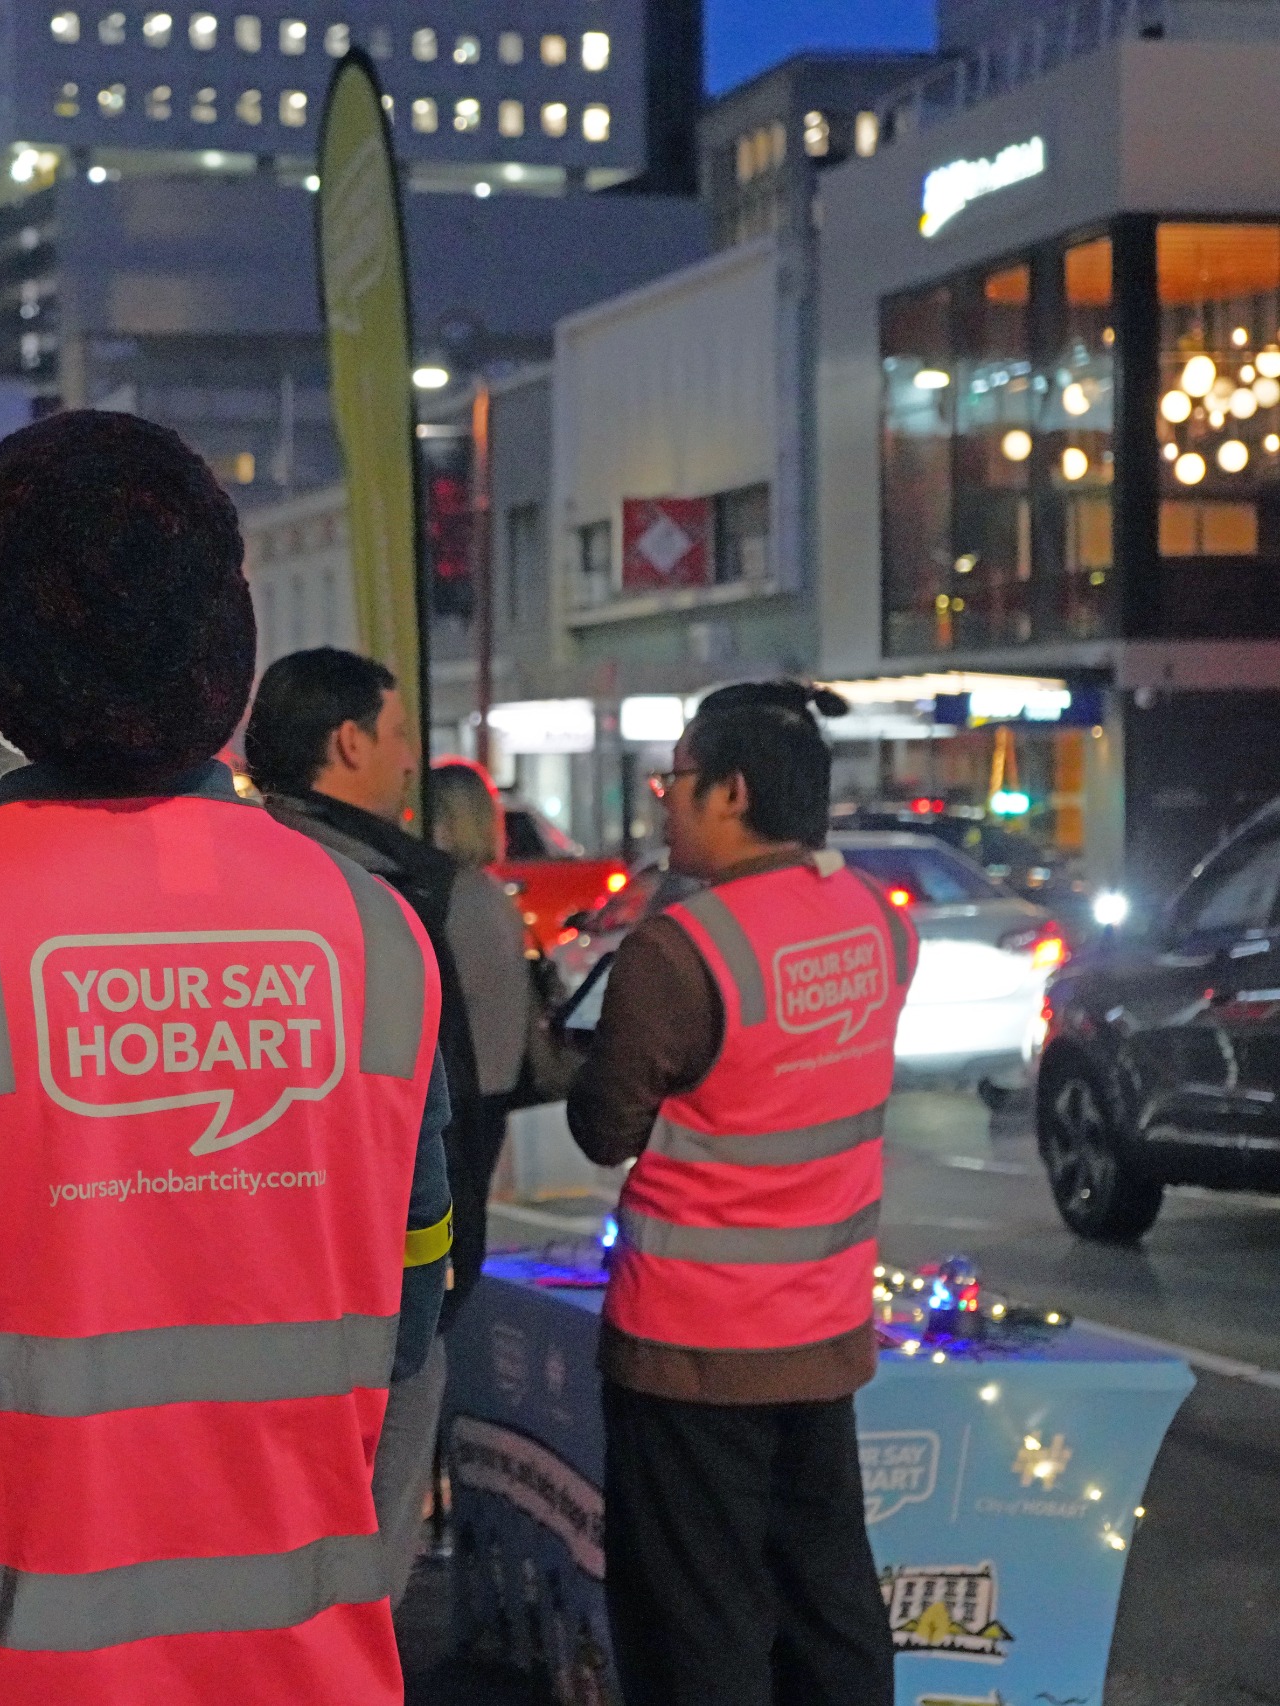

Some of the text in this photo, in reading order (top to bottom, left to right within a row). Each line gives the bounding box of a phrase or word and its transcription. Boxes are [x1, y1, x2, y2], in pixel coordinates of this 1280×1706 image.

[61, 964, 315, 1013] YOUR SAY
[786, 943, 875, 985] YOUR SAY
[786, 968, 878, 1017] HOBART
[66, 1019, 321, 1078] HOBART
[883, 1443, 928, 1465] SAY
